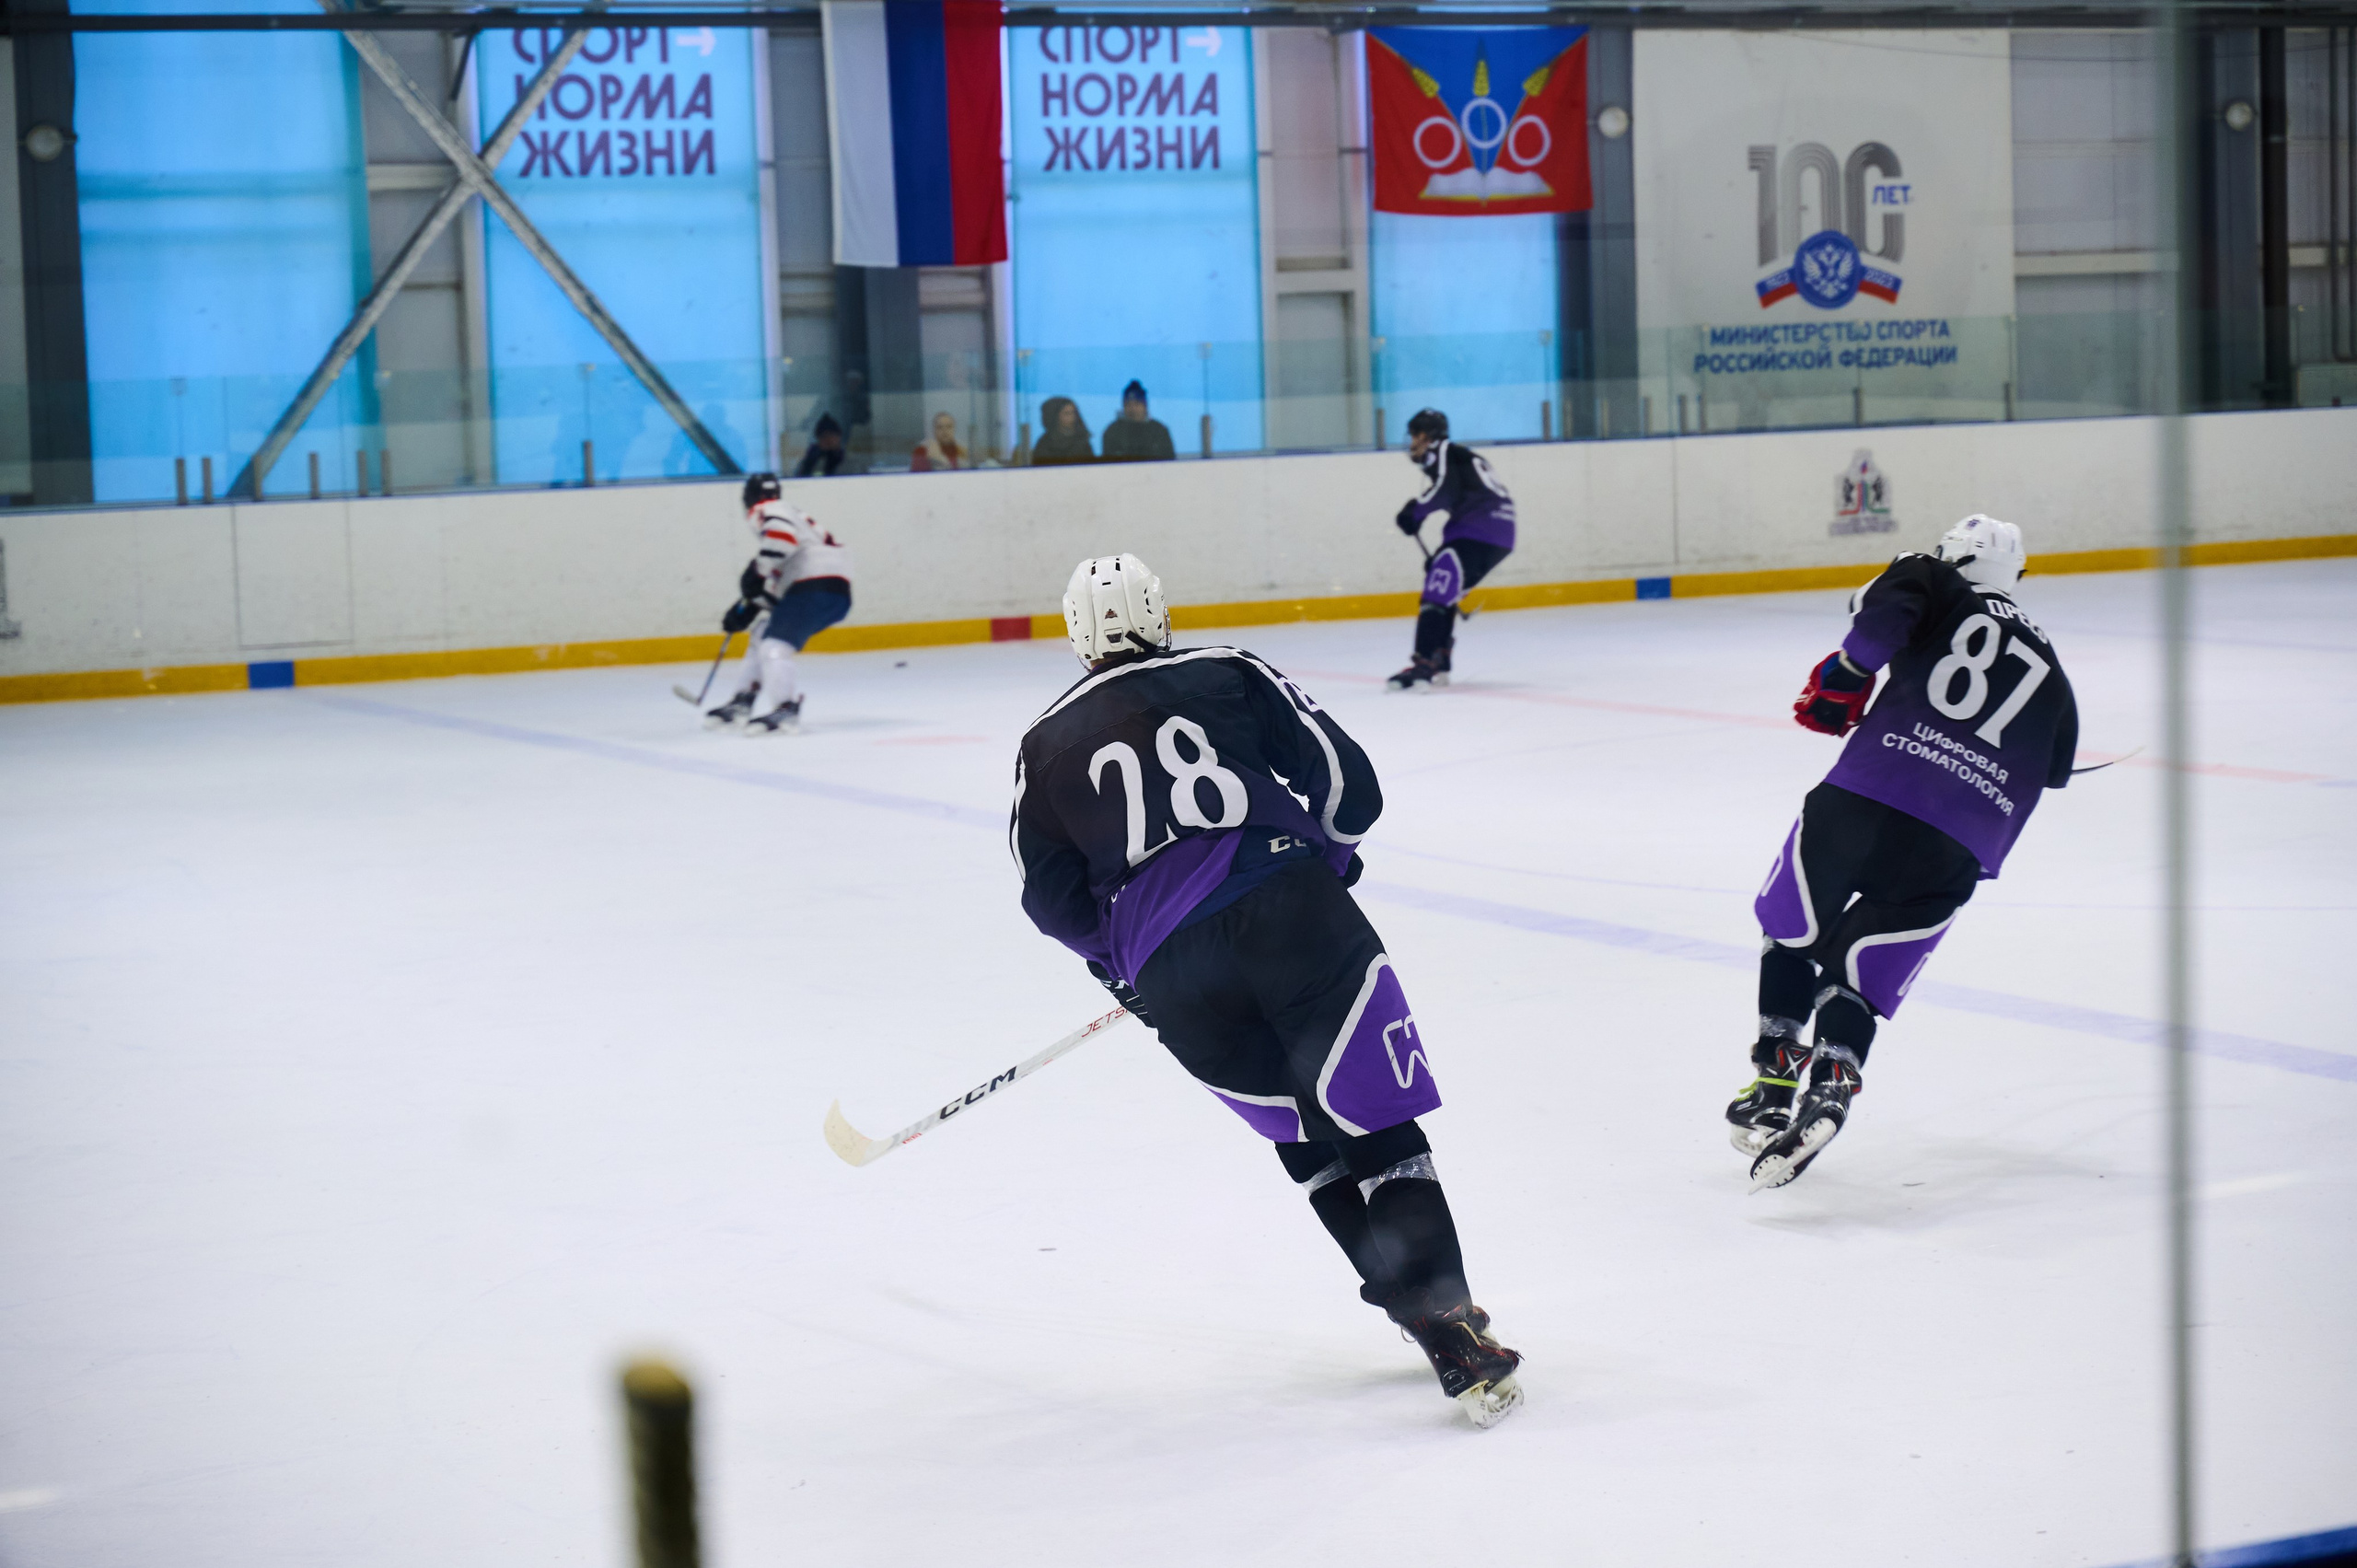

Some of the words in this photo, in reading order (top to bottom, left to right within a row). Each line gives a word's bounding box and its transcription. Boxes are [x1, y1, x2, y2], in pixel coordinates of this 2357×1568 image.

[1039, 26, 1179, 63] СПОРТ
[1041, 73, 1218, 117] НОРМА
[518, 130, 715, 177] ЖИЗНИ
[1043, 125, 1220, 171] ЖИЗНИ
[1872, 185, 1911, 204] ЛЕТ
[1710, 321, 1872, 346] МИНИСТЕРСТВО
[1876, 319, 1950, 342] СПОРТА
[1693, 346, 1832, 374] РОССИЙСКОЙ
[1838, 345, 1958, 369] ФЕДЕРАЦИИ
[1927, 613, 2050, 749] 87
[1882, 733, 2014, 816] СТОМАТОЛОГИЯ
[1912, 722, 2009, 784] ЦИФРОВАЯ
[1088, 716, 1248, 869] 28
[1081, 1005, 1129, 1038] JETS
[939, 1065, 1017, 1120] CCM
